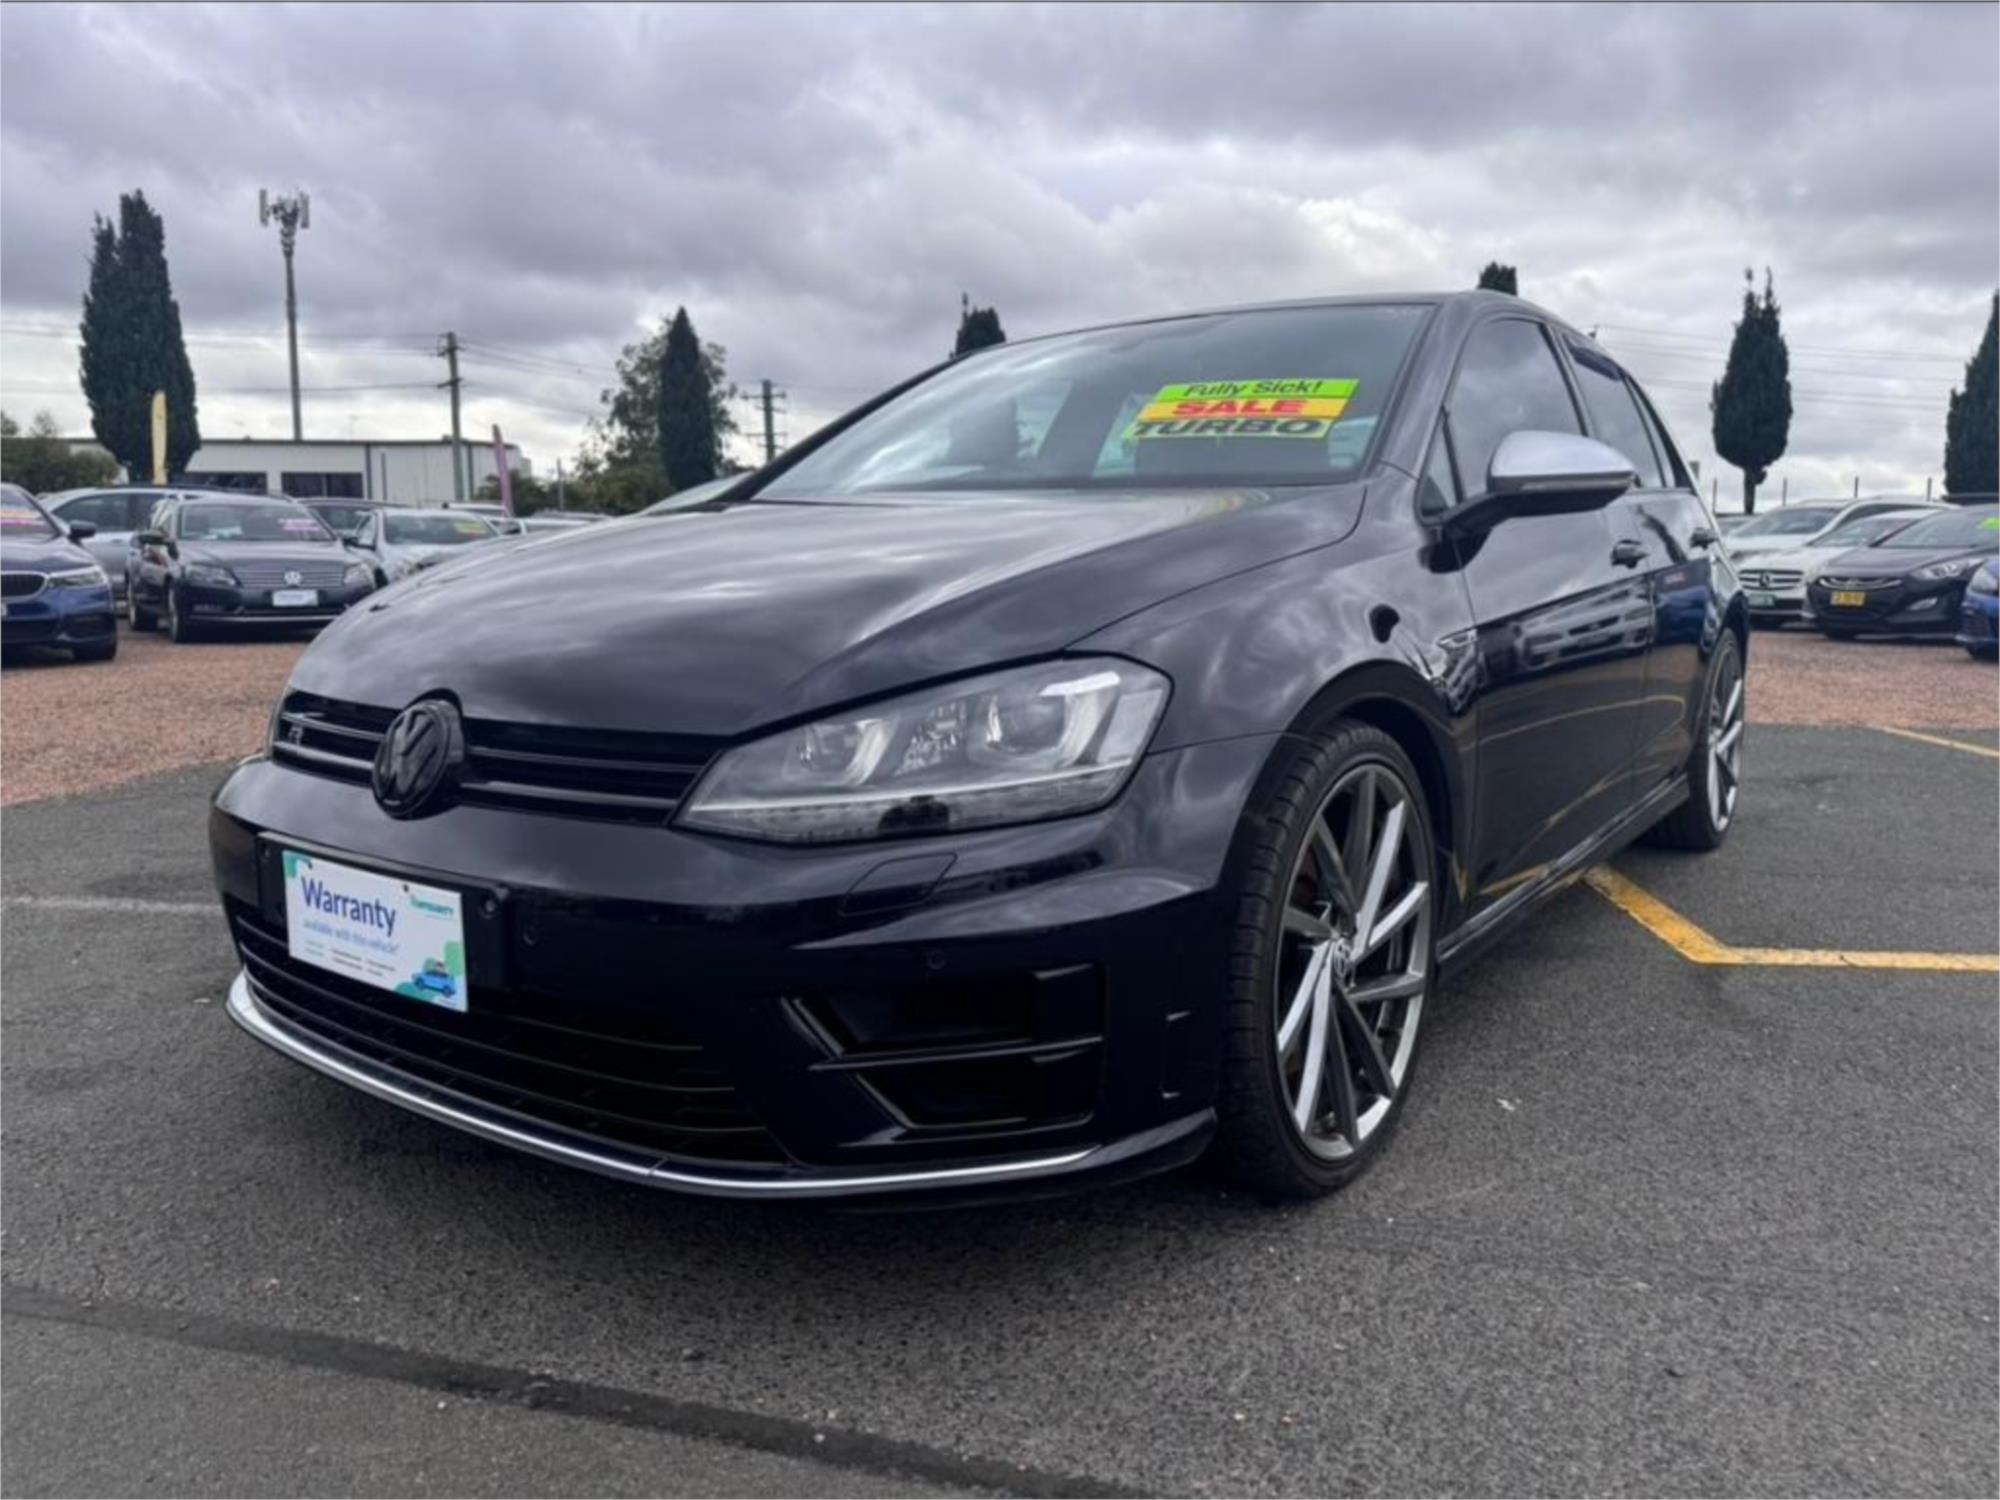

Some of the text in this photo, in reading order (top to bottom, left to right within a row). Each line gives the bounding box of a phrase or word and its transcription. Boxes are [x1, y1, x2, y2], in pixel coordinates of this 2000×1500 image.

[1183, 380, 1323, 397] Fully Sick!
[1172, 400, 1308, 417] SALE
[1134, 419, 1322, 436] TURBO
[301, 875, 396, 937] Warranty
